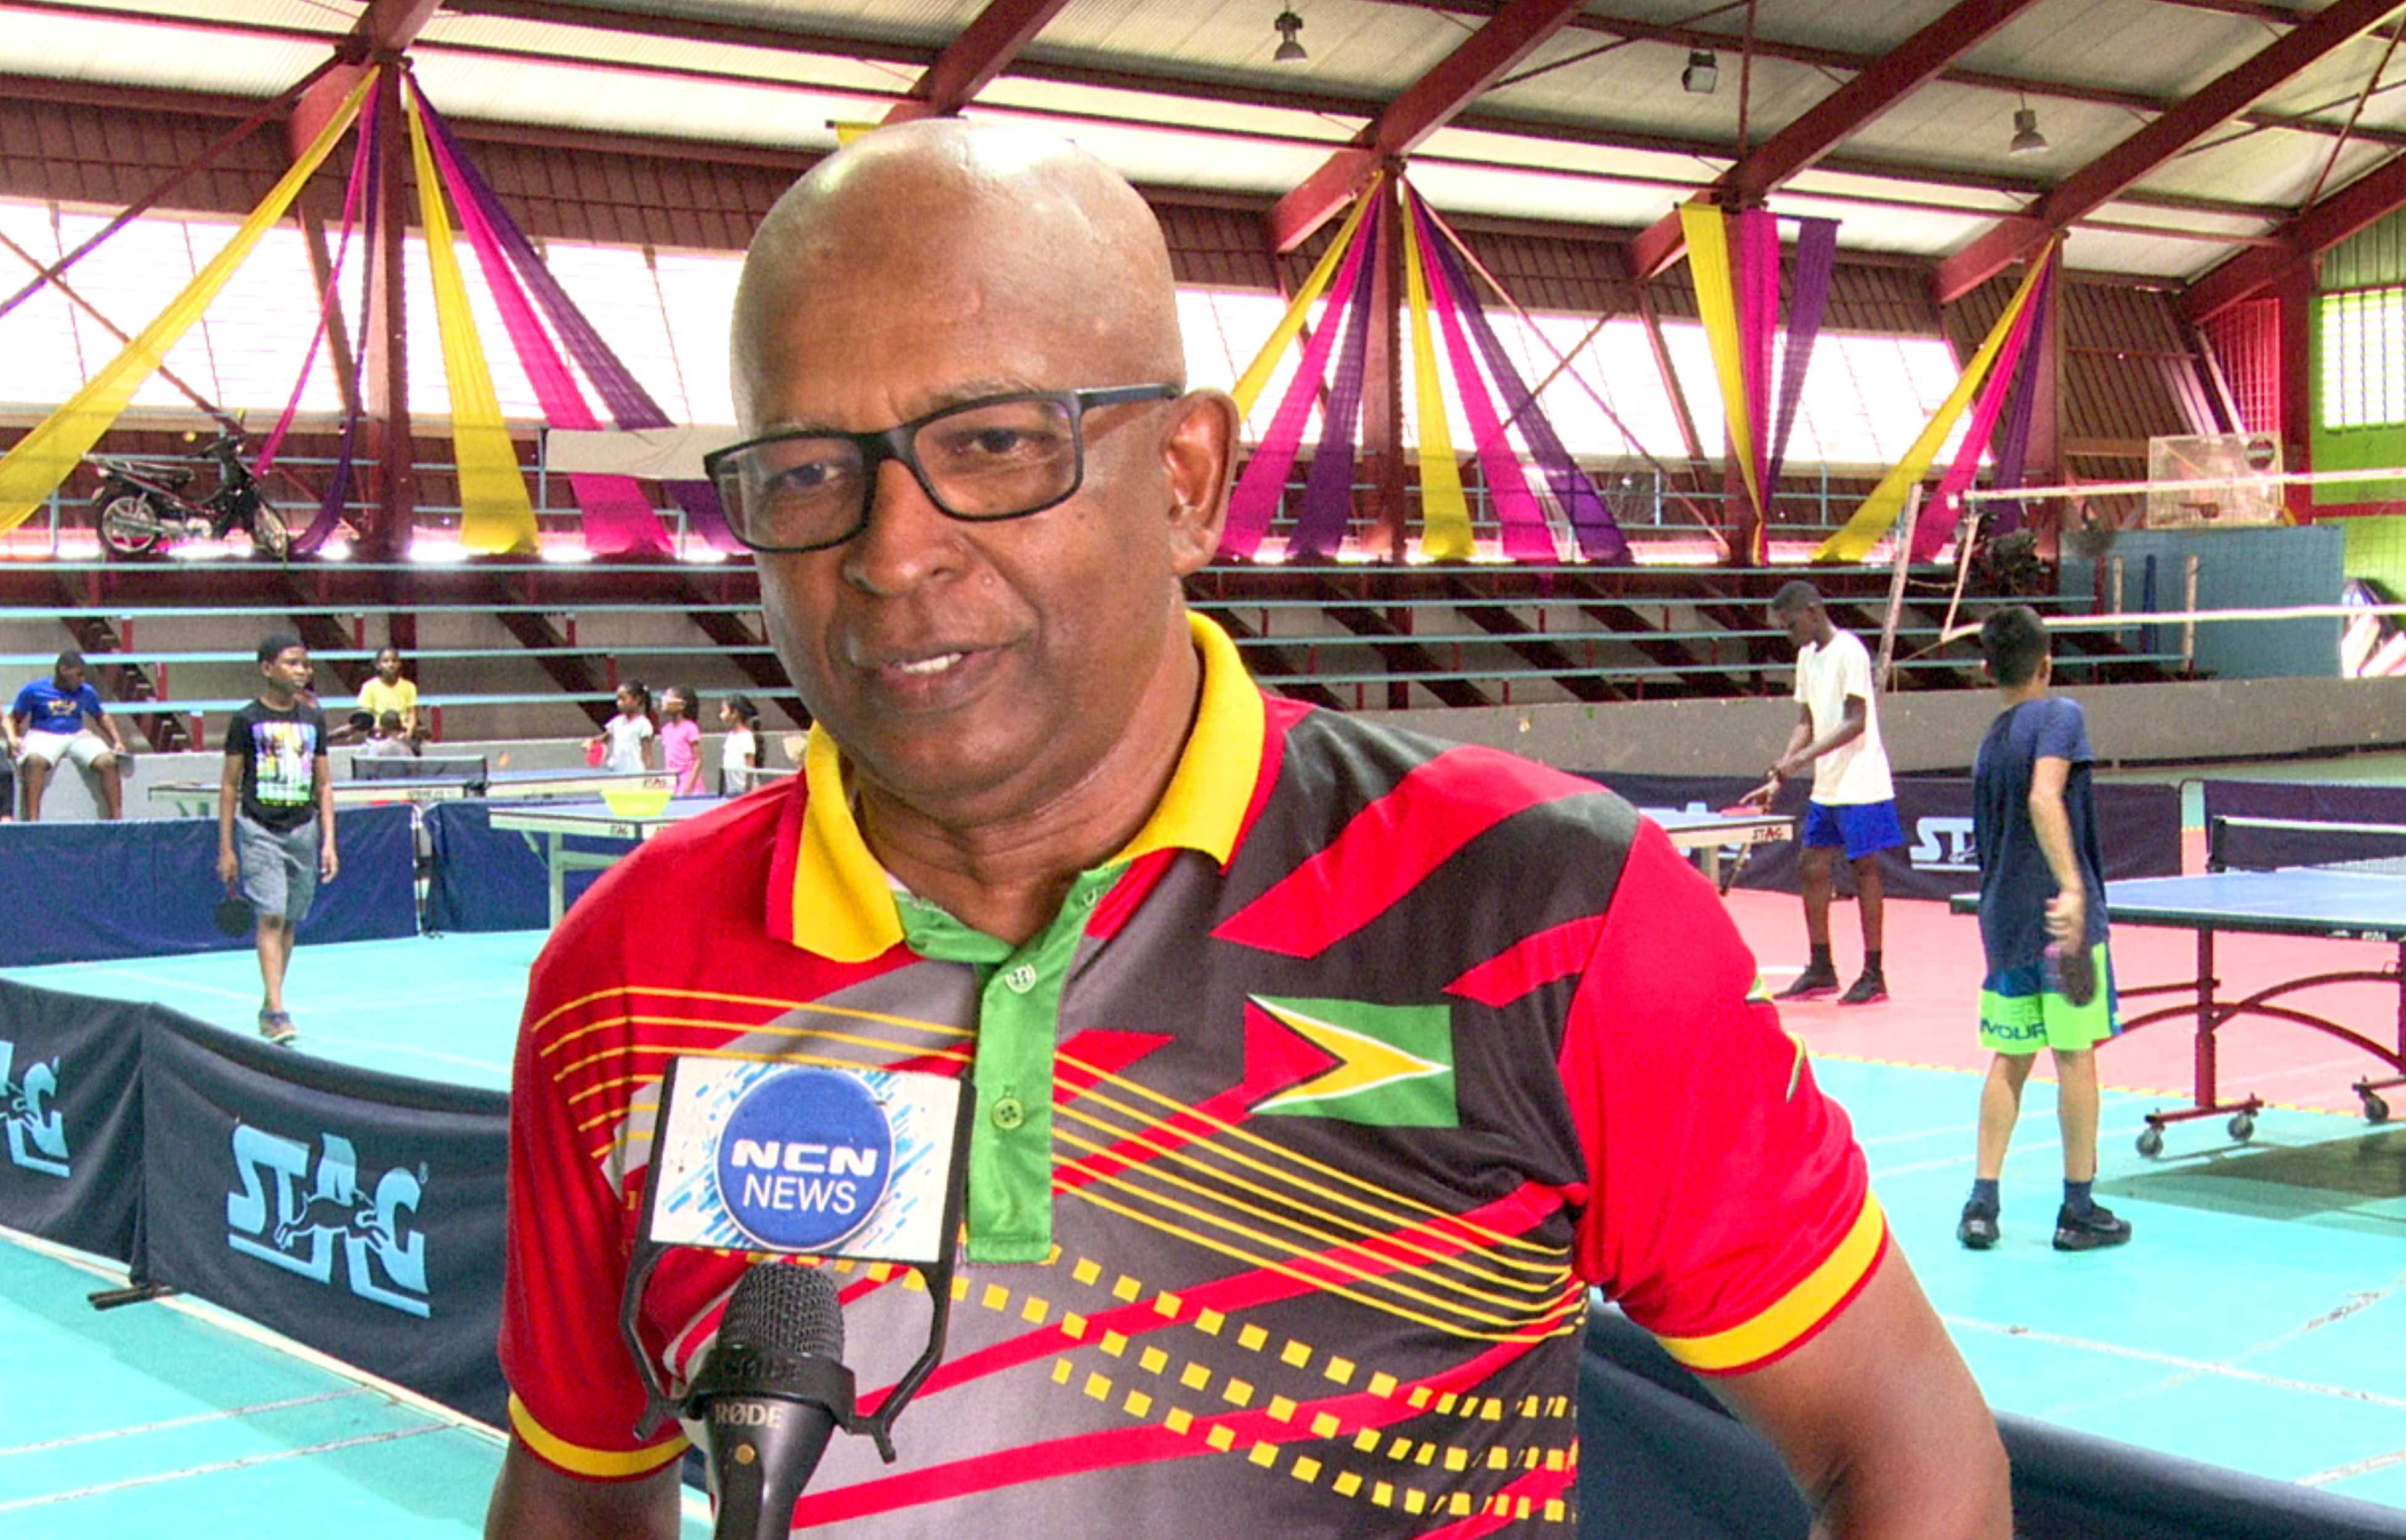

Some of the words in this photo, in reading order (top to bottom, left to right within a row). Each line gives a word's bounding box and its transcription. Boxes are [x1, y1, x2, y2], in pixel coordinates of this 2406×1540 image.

[1753, 827, 1783, 841] STAG
[731, 1138, 878, 1177] NCN
[743, 1172, 857, 1215] NEWS
[228, 1124, 430, 1318] STAG
[715, 1401, 783, 1429] RØDE
